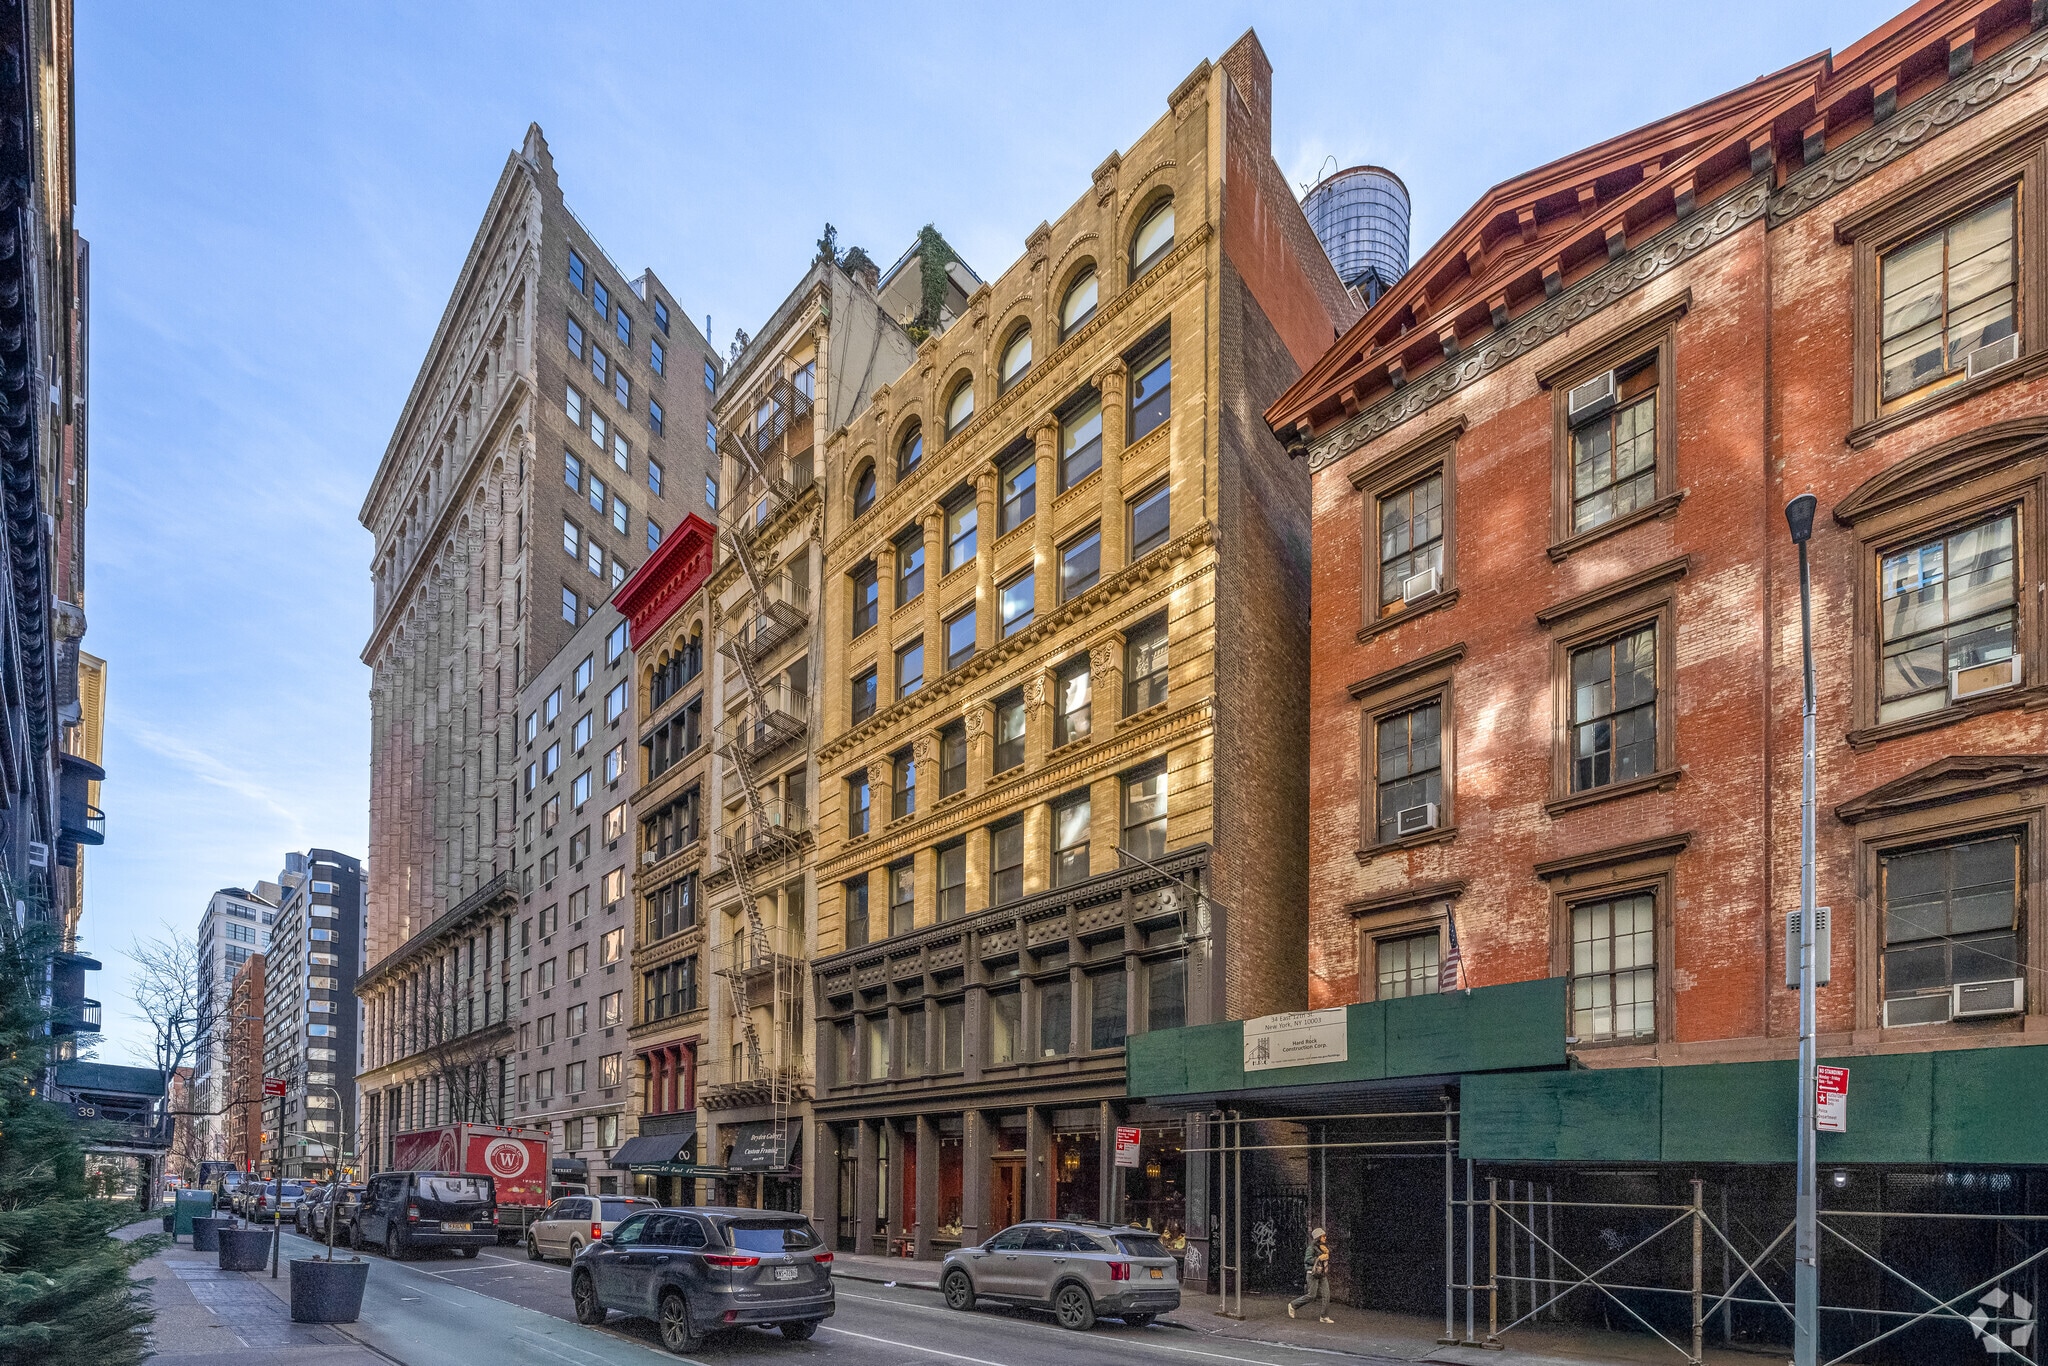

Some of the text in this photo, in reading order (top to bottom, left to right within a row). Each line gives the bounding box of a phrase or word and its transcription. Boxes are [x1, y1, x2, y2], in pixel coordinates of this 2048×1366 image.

[1282, 1044, 1313, 1052] Construction
[77, 1106, 96, 1118] 39
[759, 1147, 779, 1155] Framing
[499, 1152, 516, 1167] W
